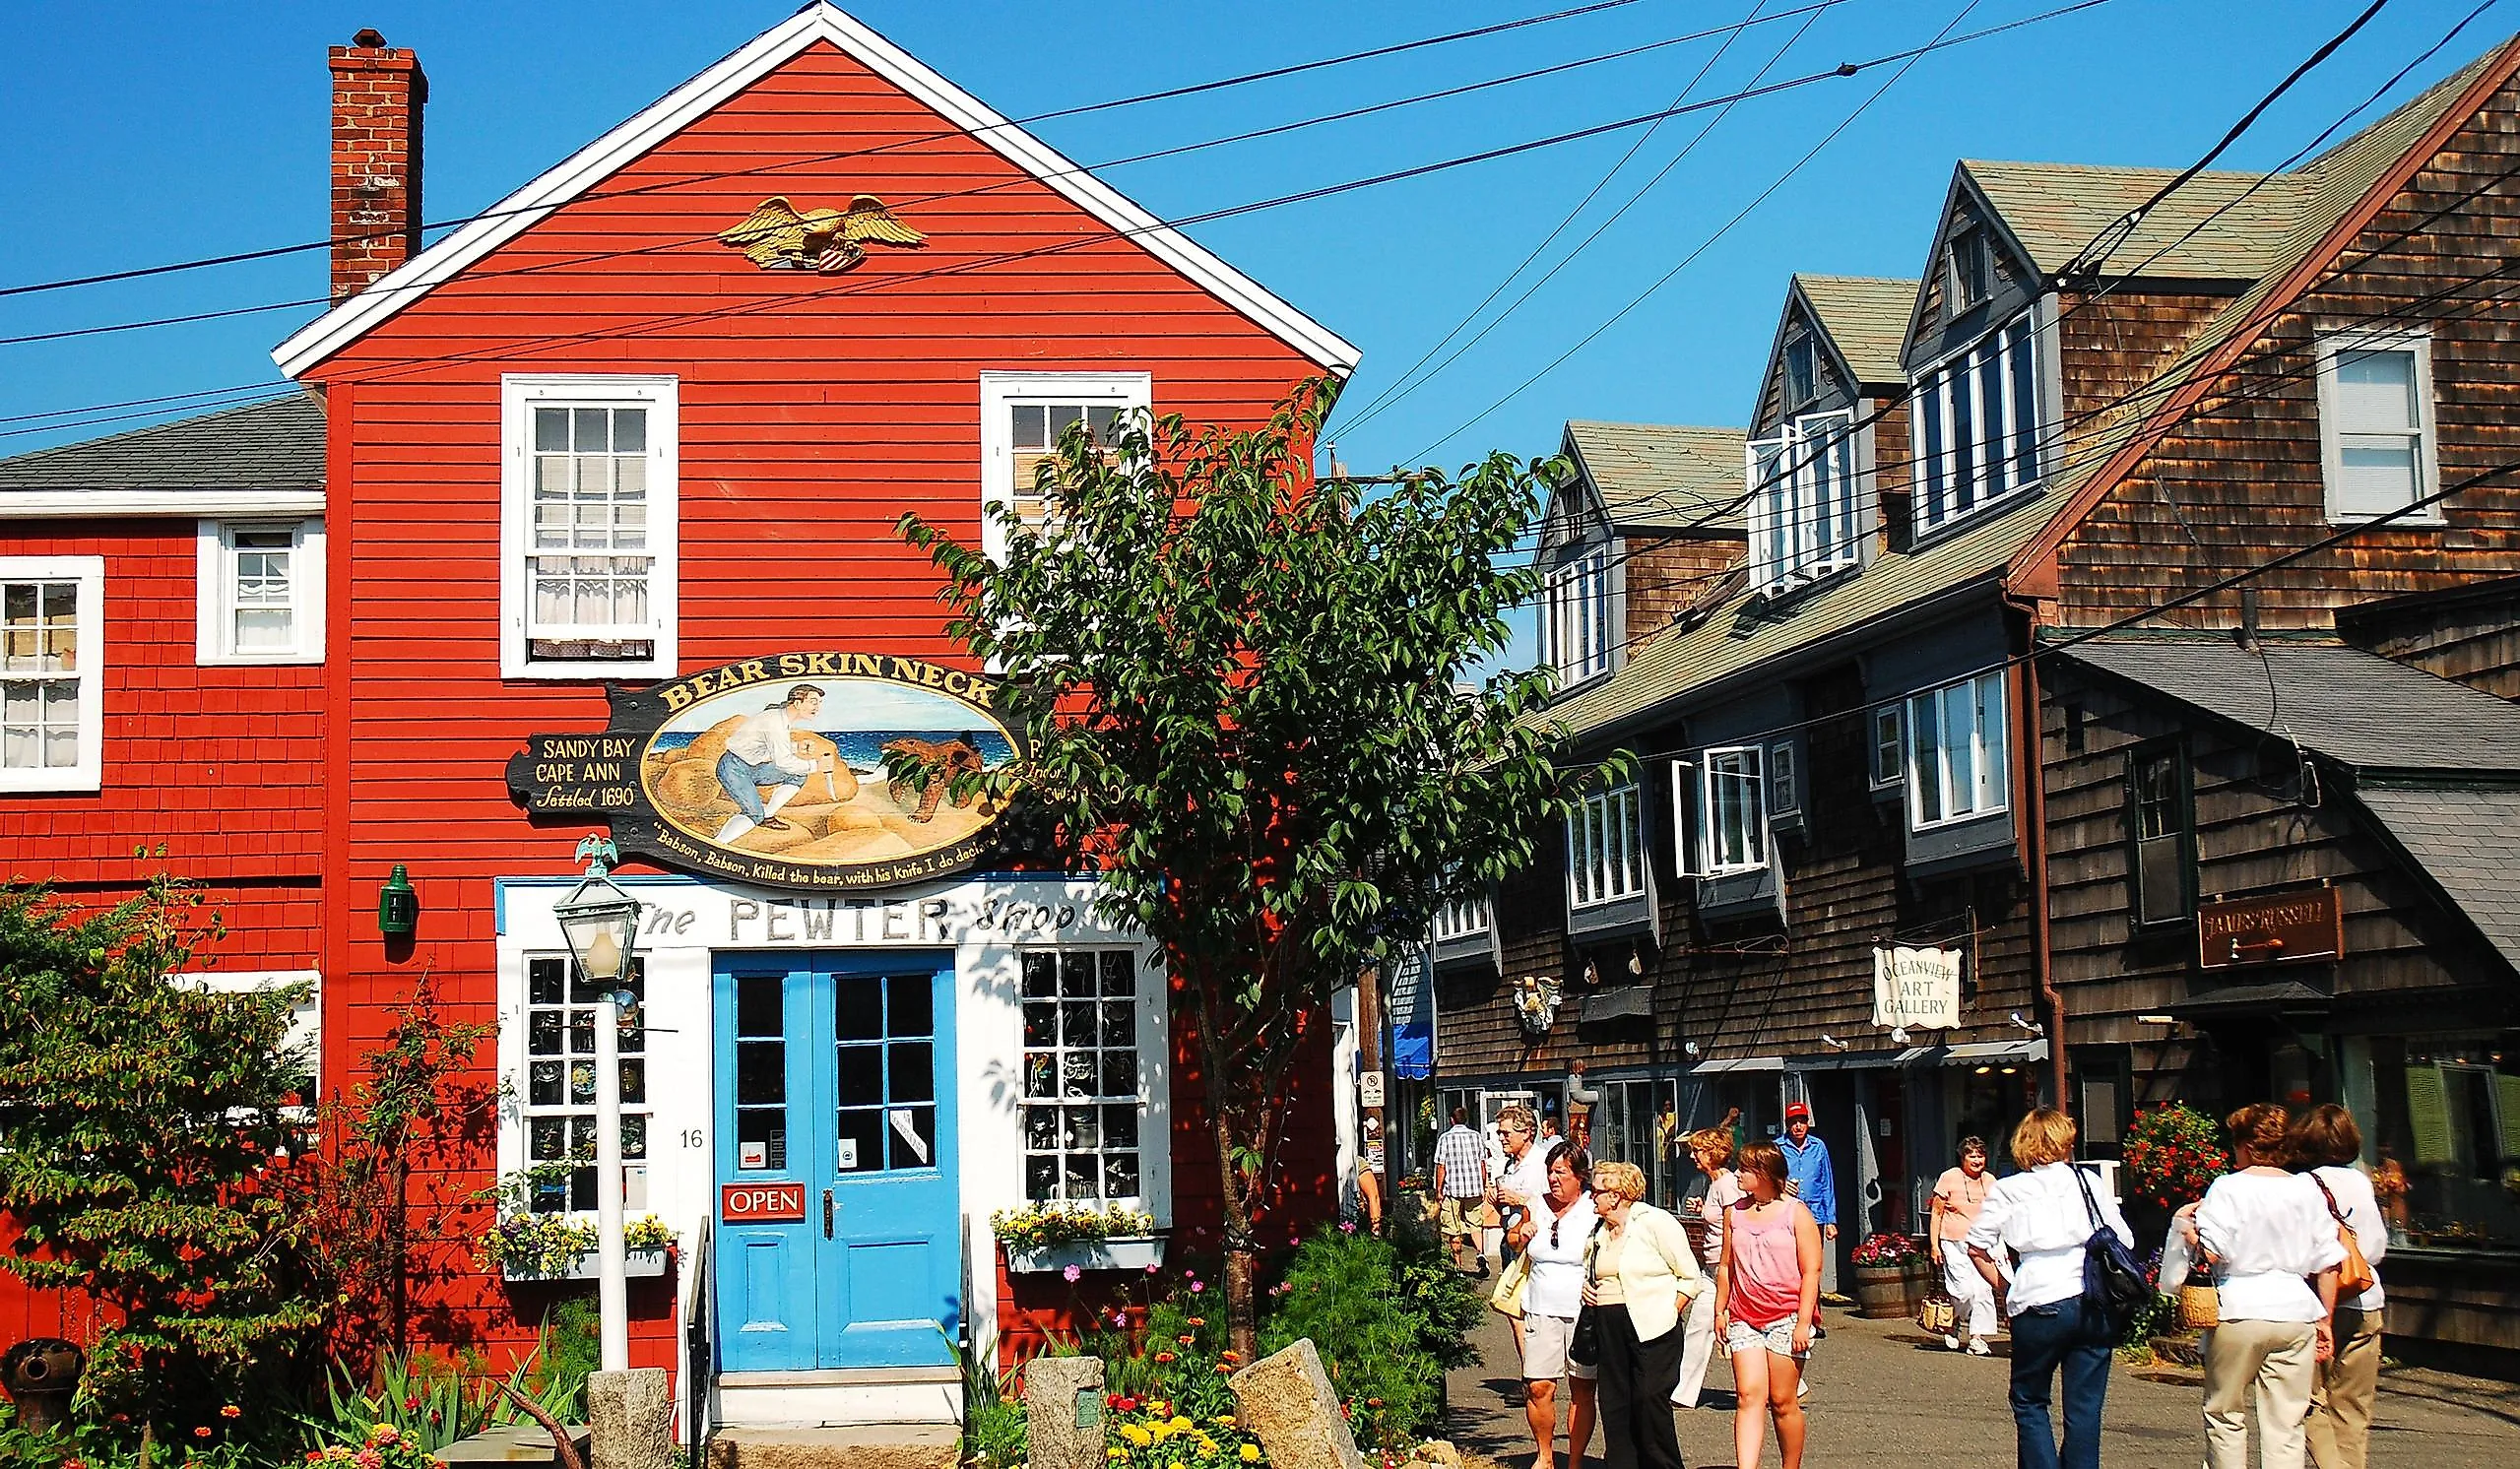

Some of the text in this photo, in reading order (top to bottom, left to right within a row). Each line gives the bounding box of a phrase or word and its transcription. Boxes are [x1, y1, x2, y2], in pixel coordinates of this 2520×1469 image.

[658, 652, 997, 713] BEAR SKIN NECK
[543, 737, 636, 759] SANDY BAY
[536, 762, 620, 783] CAPE ANN
[536, 785, 634, 807] Settled 1690
[704, 850, 749, 878] Babson,
[790, 868, 809, 884] the
[812, 870, 844, 886] bear,
[845, 869, 875, 885] with
[875, 865, 891, 882] his
[924, 858, 936, 873] I
[938, 855, 954, 869] do
[730, 896, 953, 941] PEWTER
[975, 897, 1076, 931] Shop
[1900, 982, 1934, 996] ART
[1884, 998, 1948, 1015] GALLERY
[680, 1129, 703, 1148] 16
[730, 1189, 799, 1213] OPEN
